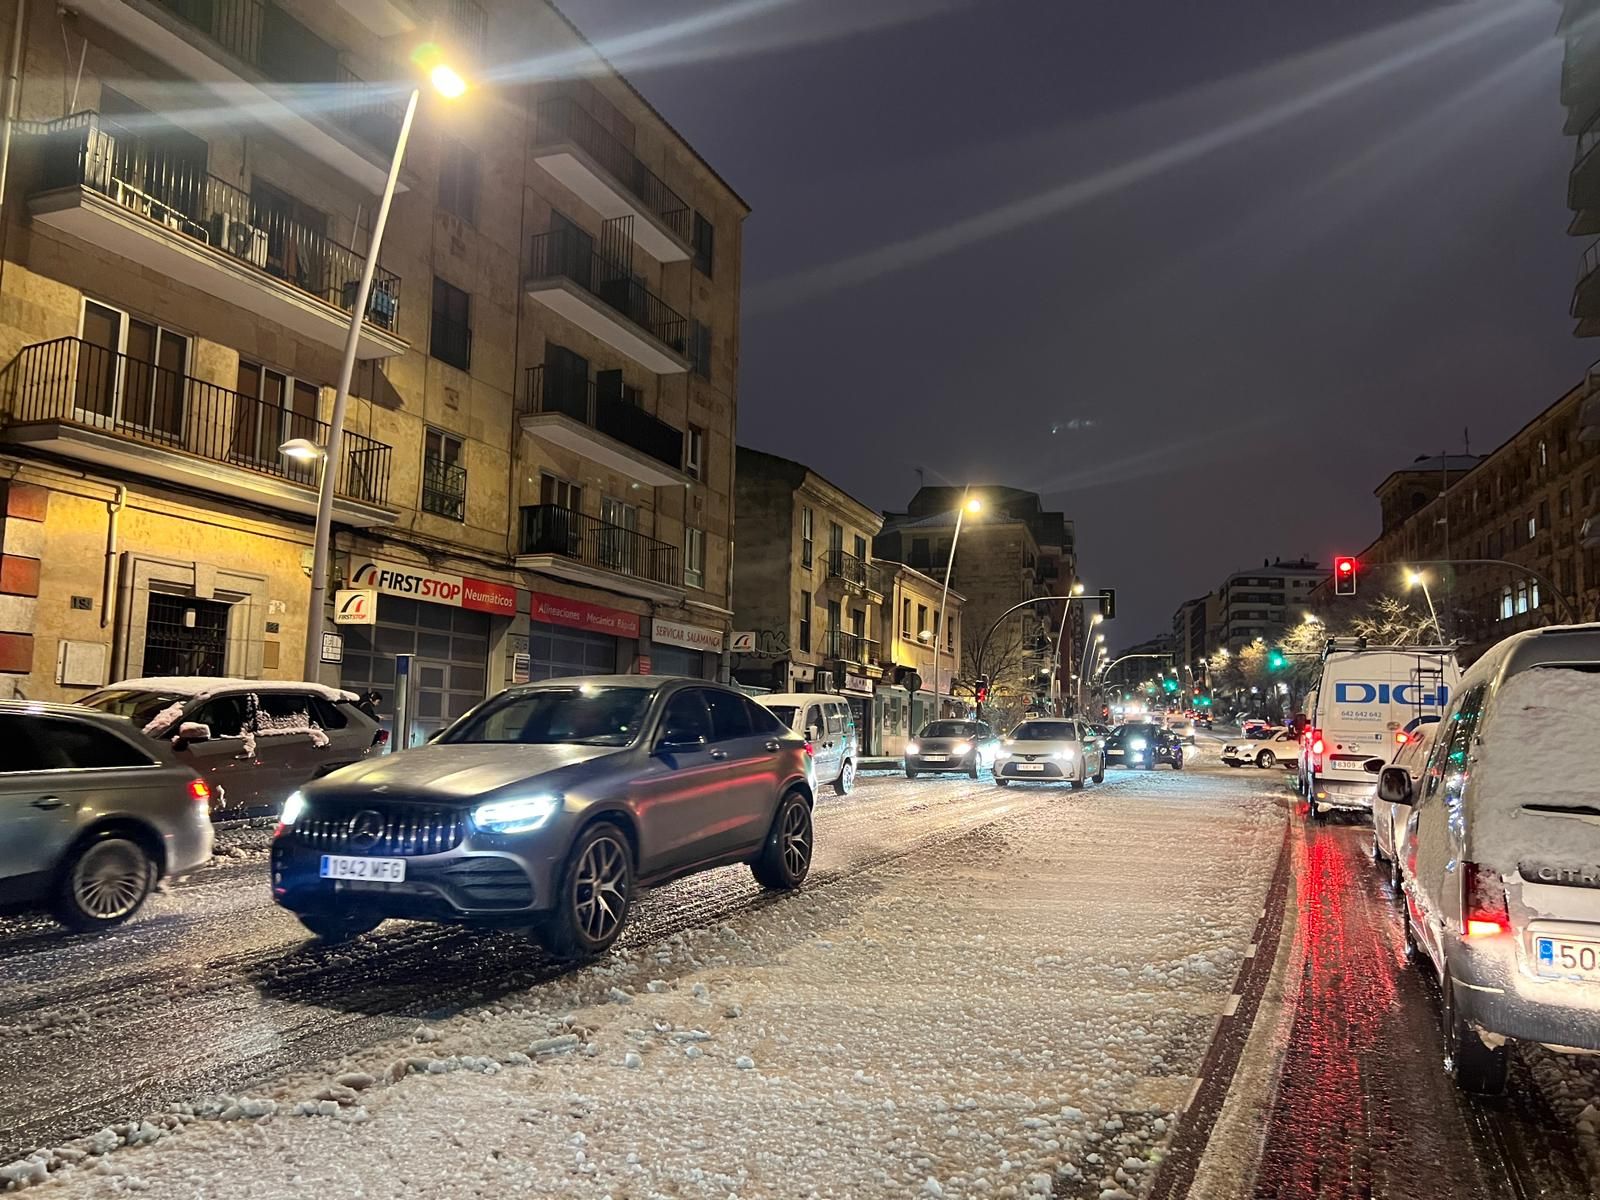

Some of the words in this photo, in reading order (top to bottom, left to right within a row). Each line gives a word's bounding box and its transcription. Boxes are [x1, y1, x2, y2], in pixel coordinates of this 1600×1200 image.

[464, 587, 513, 607] Neumáticos
[538, 602, 580, 620] Alineaciones
[656, 625, 685, 641] SERVICAR
[686, 632, 720, 647] SALAMANCA
[1335, 682, 1449, 706] DIGI
[332, 858, 367, 877] 1942
[1560, 945, 1600, 971] 50
